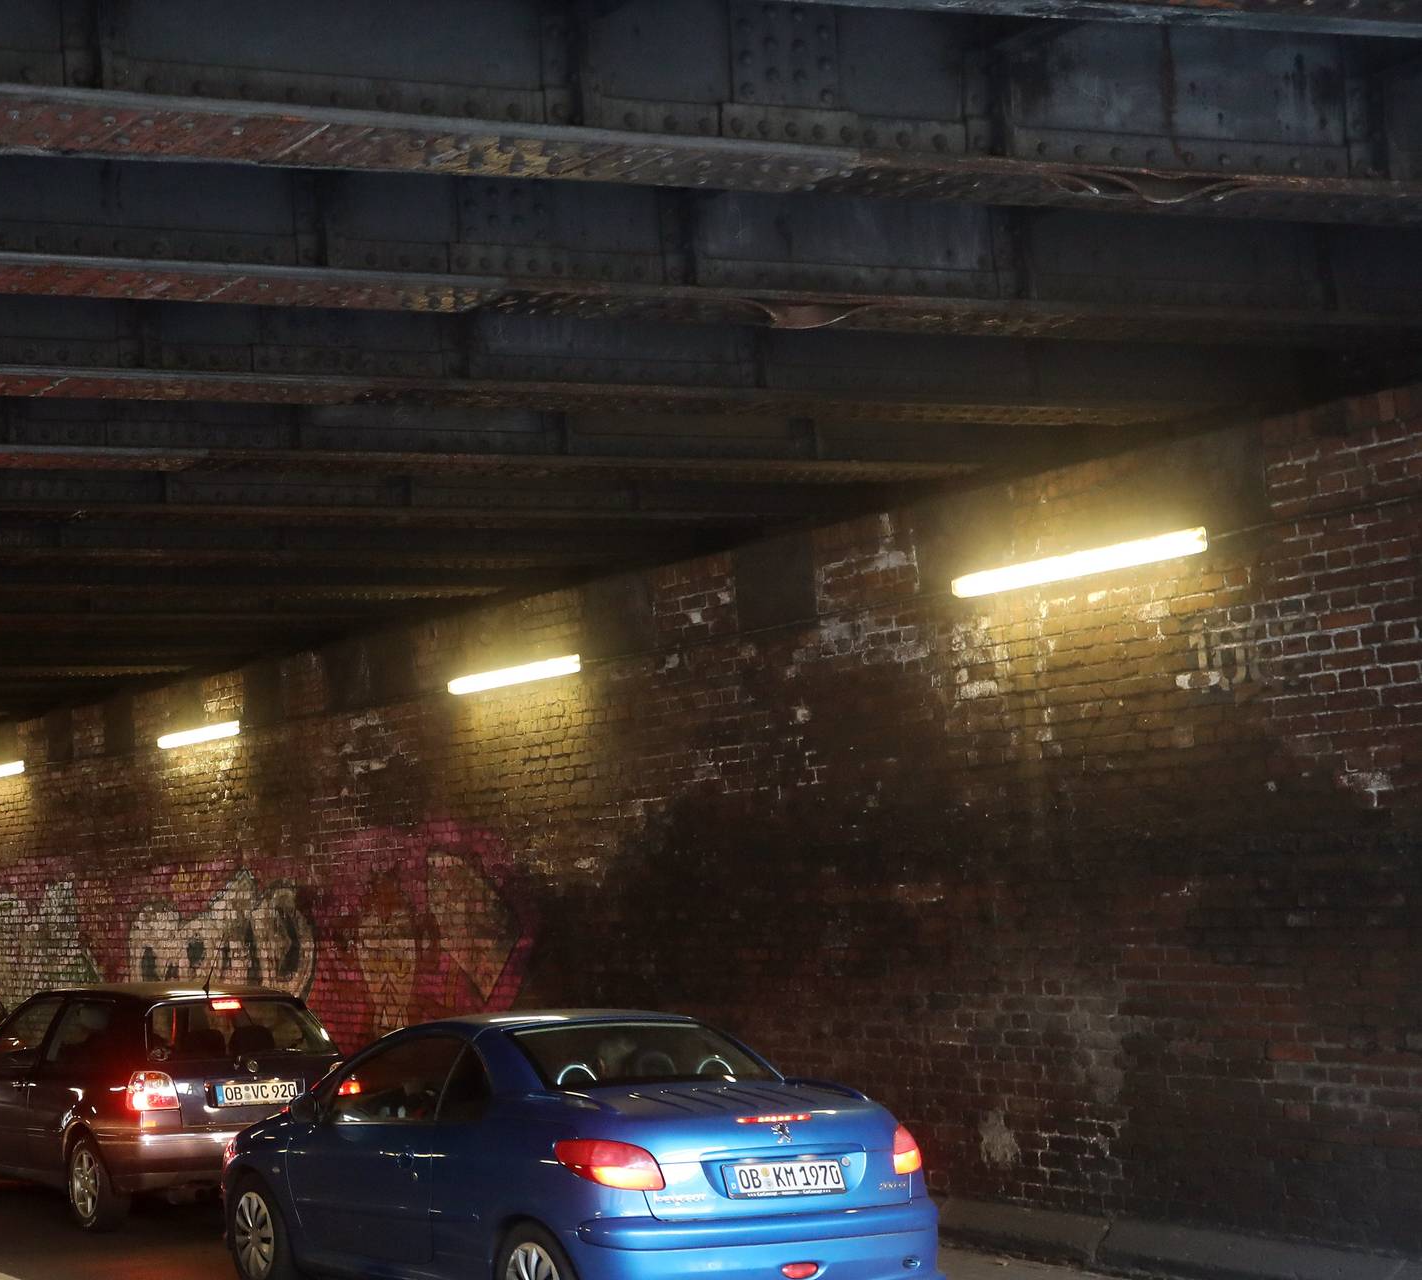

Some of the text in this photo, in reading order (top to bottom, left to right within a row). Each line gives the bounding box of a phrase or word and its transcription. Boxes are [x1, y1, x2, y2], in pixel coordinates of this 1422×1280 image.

[225, 1083, 296, 1101] OB VC 920
[738, 1165, 841, 1190] OB KM 1970
